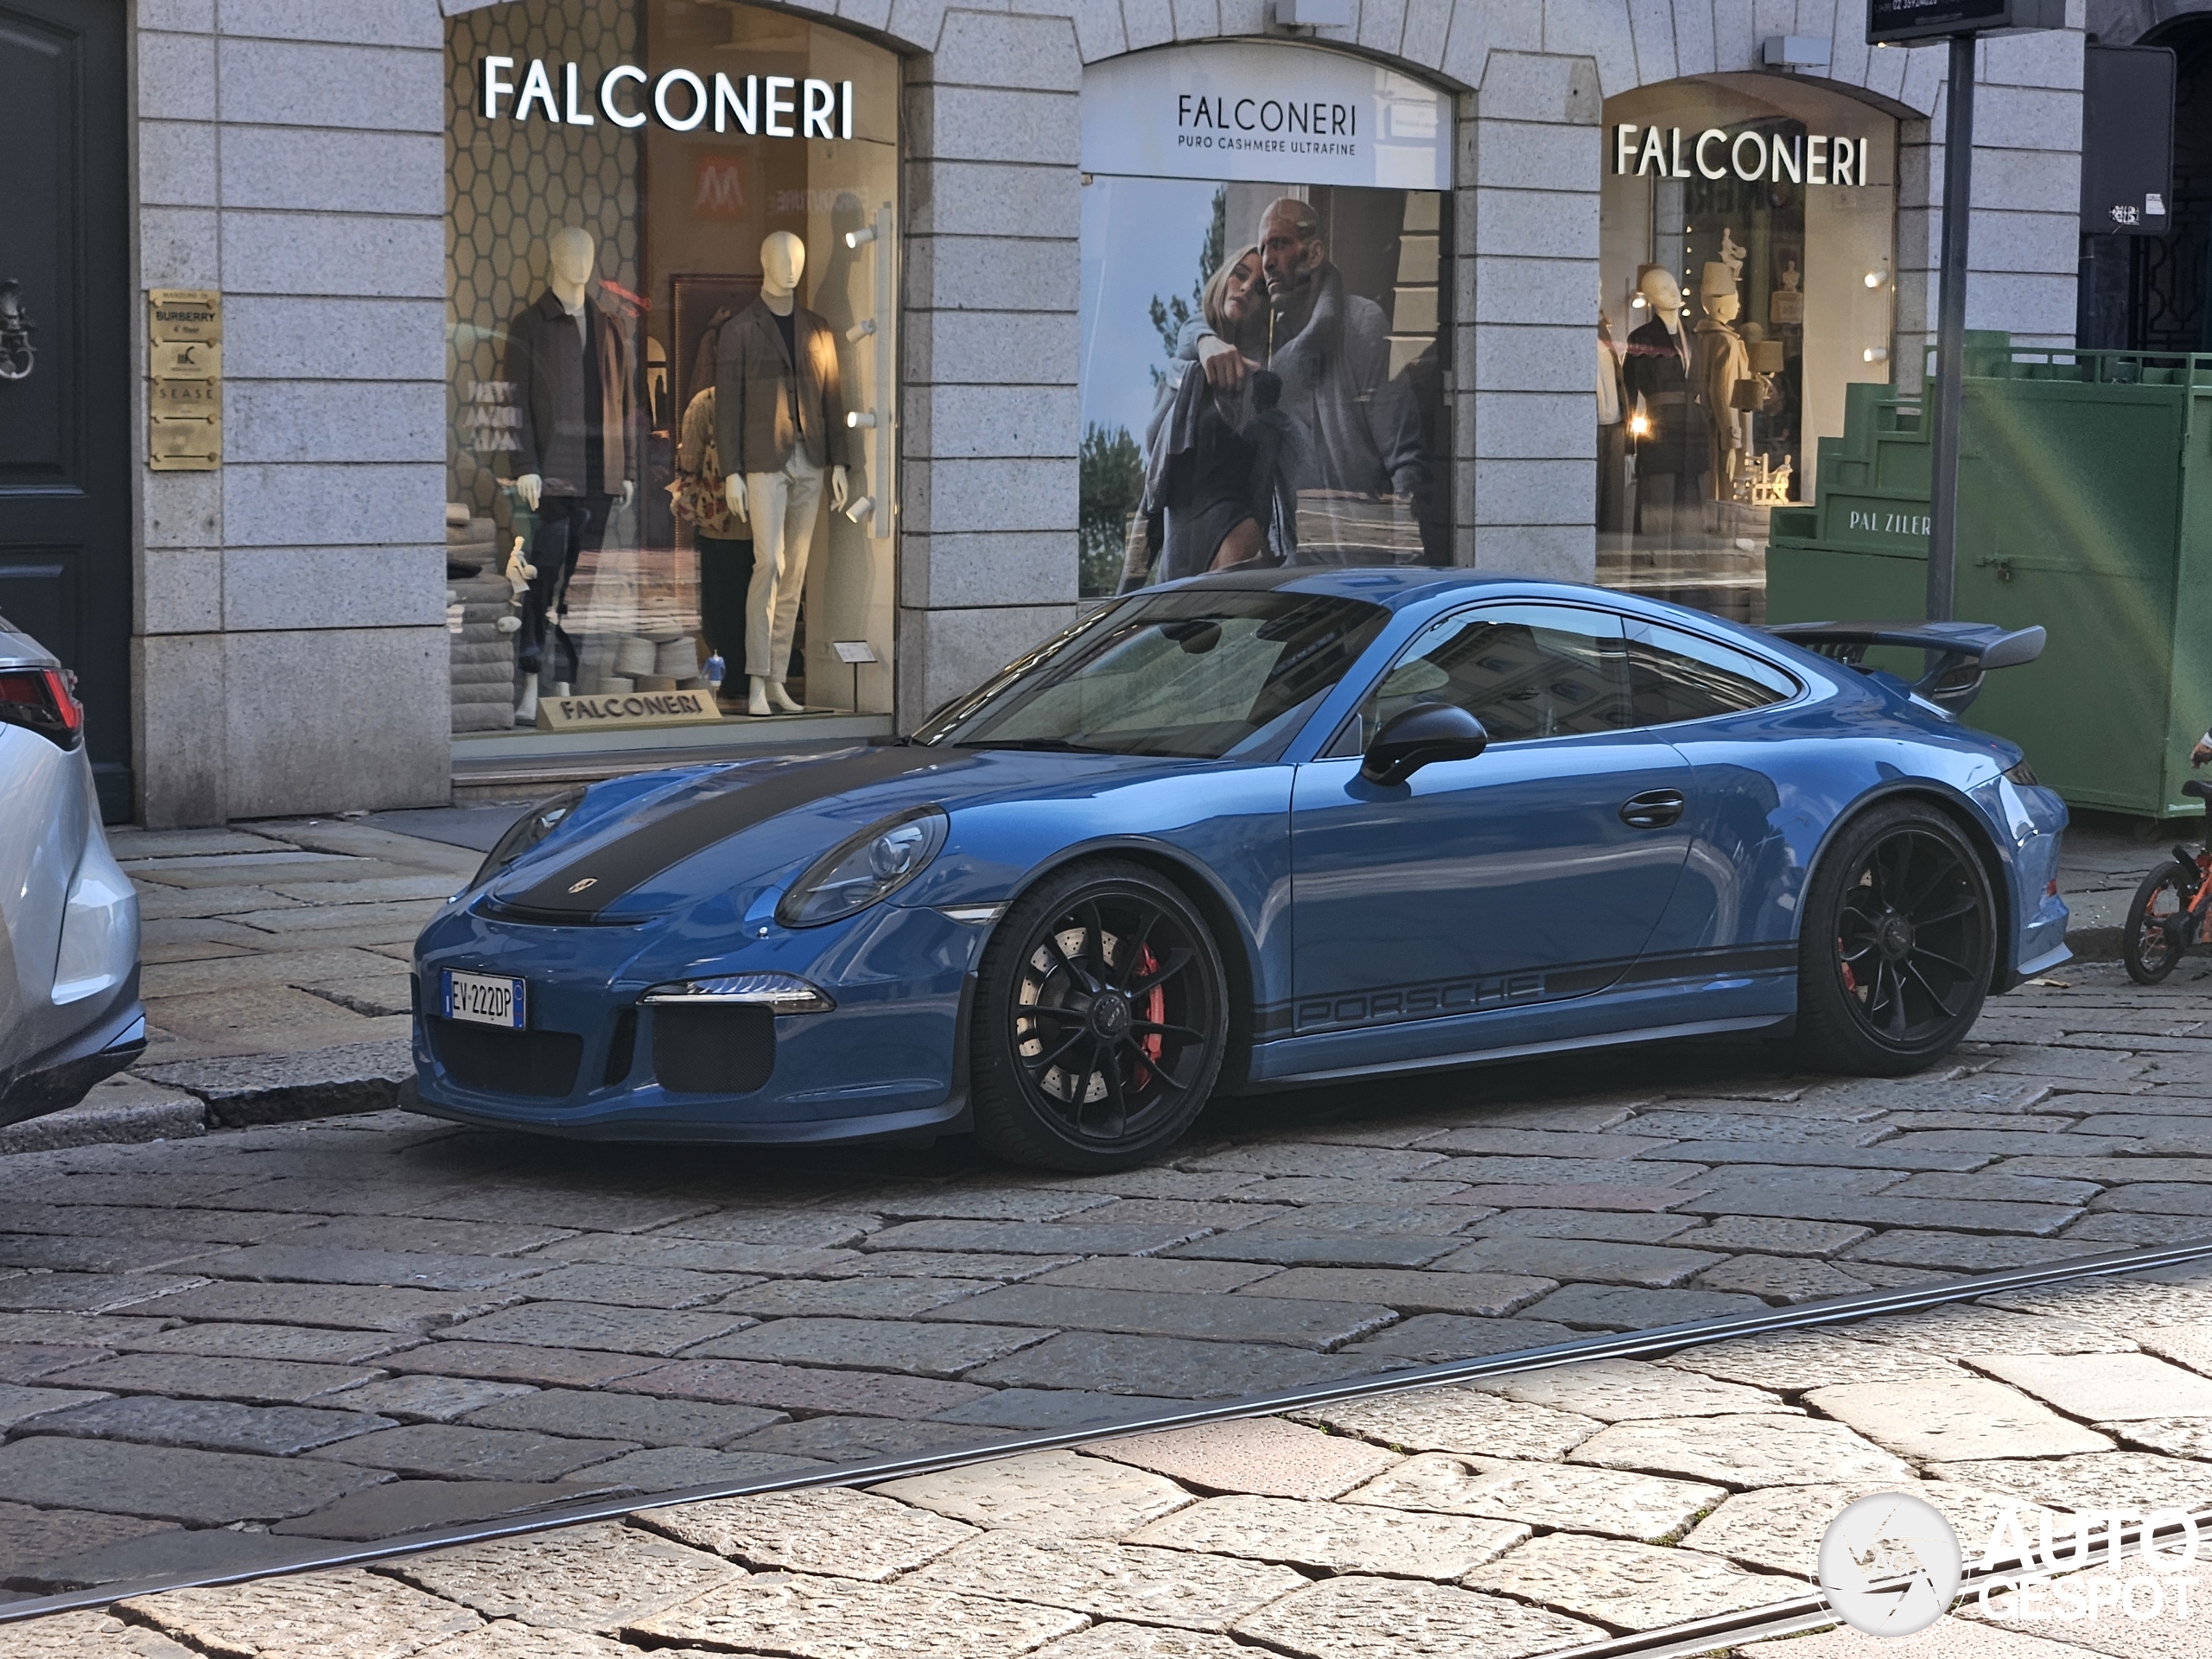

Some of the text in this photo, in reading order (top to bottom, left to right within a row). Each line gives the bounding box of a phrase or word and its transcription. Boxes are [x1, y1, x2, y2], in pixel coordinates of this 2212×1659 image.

[485, 55, 853, 140] FALCONERI
[1179, 94, 1356, 137] FALCONERI
[1178, 135, 1356, 156] PURO CASHMERE ULTRAFINE
[1617, 124, 1867, 186] FALCONERI
[156, 311, 216, 322] BURBERRY
[159, 388, 213, 399] SEASE
[1849, 510, 1931, 536] PAL ZILER
[560, 693, 704, 721] FALCONERI
[1298, 973, 1540, 1029] PORSCHE
